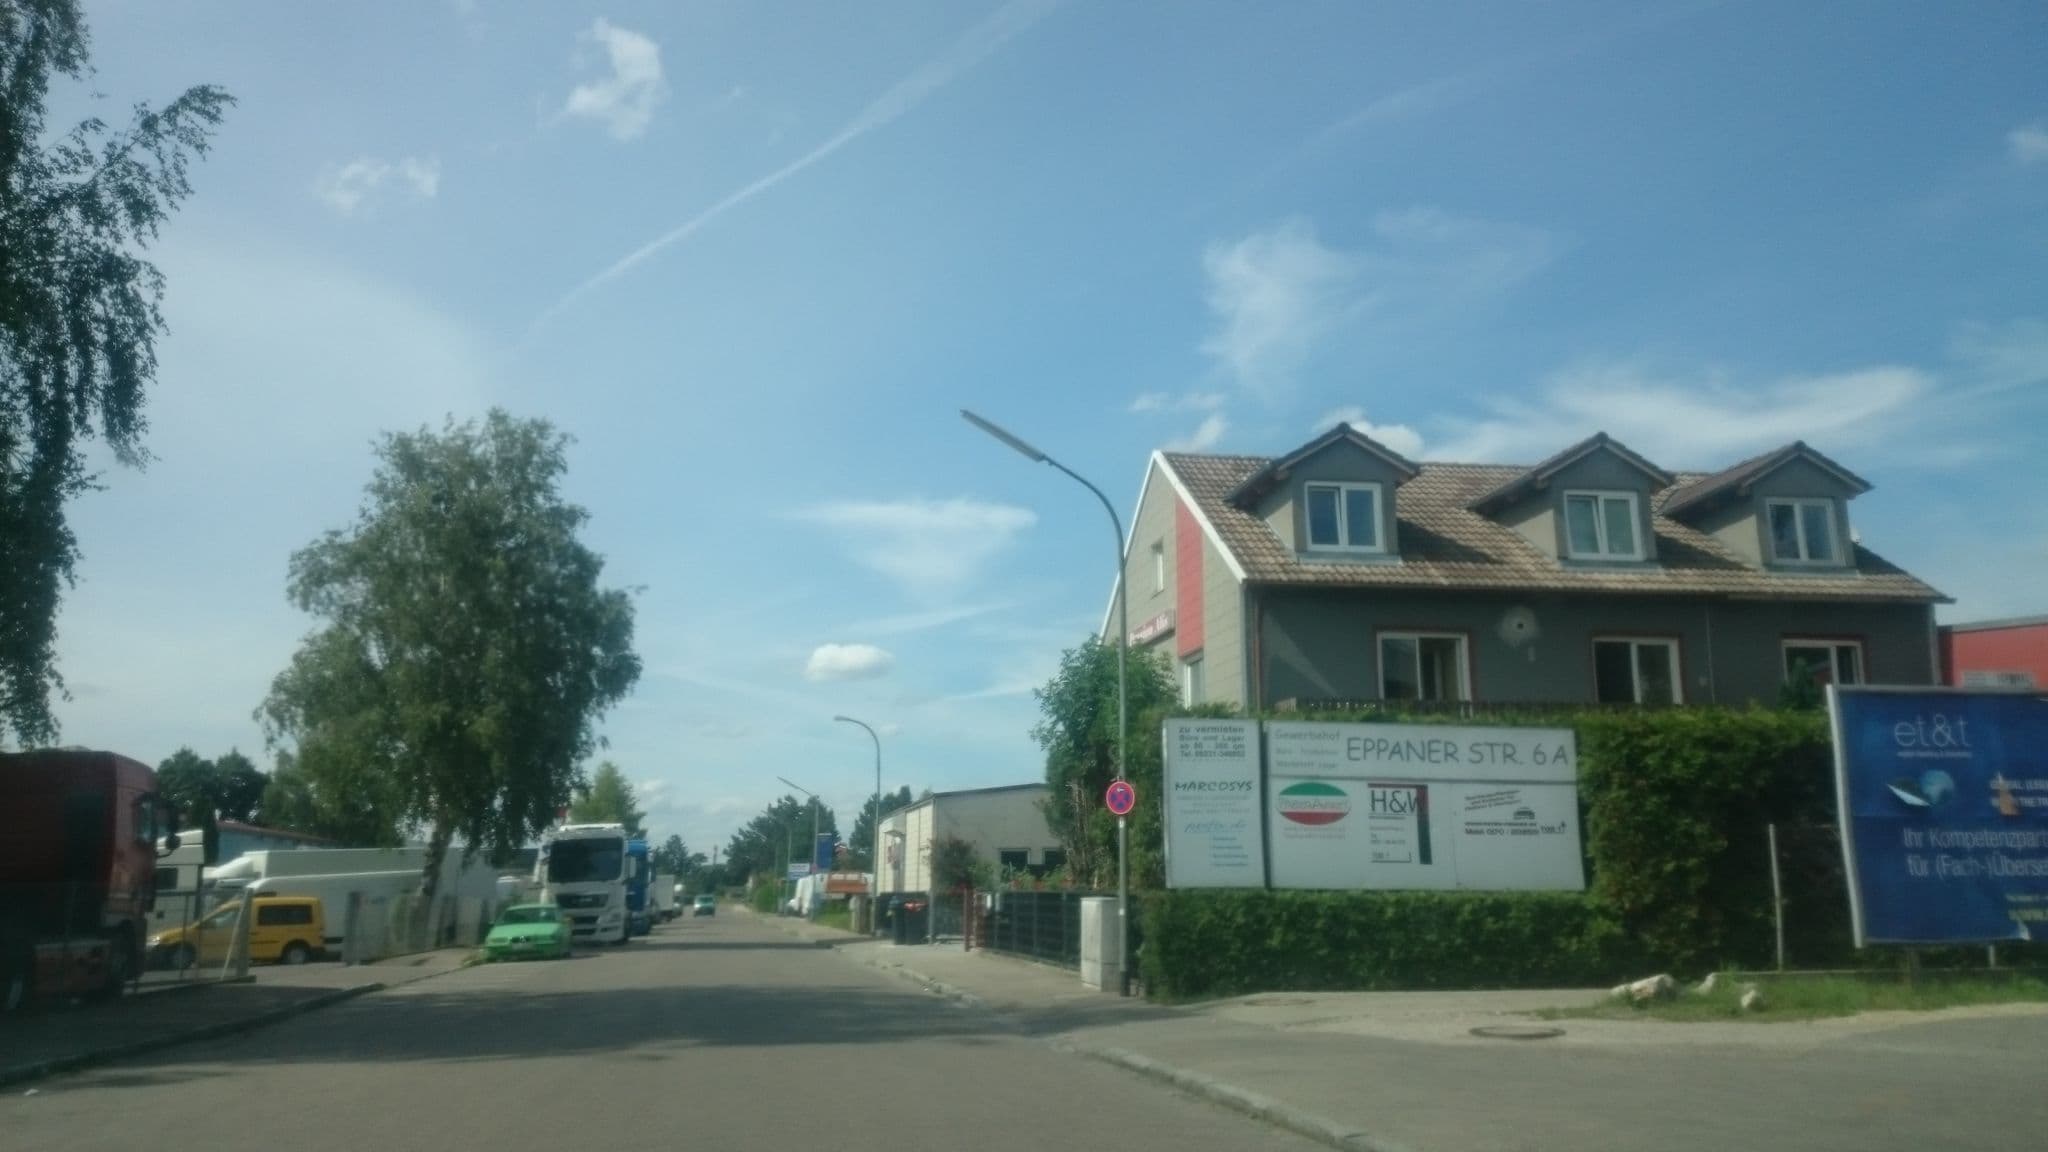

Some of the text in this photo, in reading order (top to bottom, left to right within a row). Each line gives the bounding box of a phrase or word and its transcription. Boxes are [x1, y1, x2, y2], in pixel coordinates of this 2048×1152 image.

[1195, 726, 1245, 734] vermieten
[1893, 713, 1973, 747] et&t
[1347, 736, 1569, 766] EPPANER STR. 6 A
[1174, 780, 1253, 792] MARCOSYS
[1903, 827, 1923, 849] Ihr
[1907, 853, 1928, 876] für
